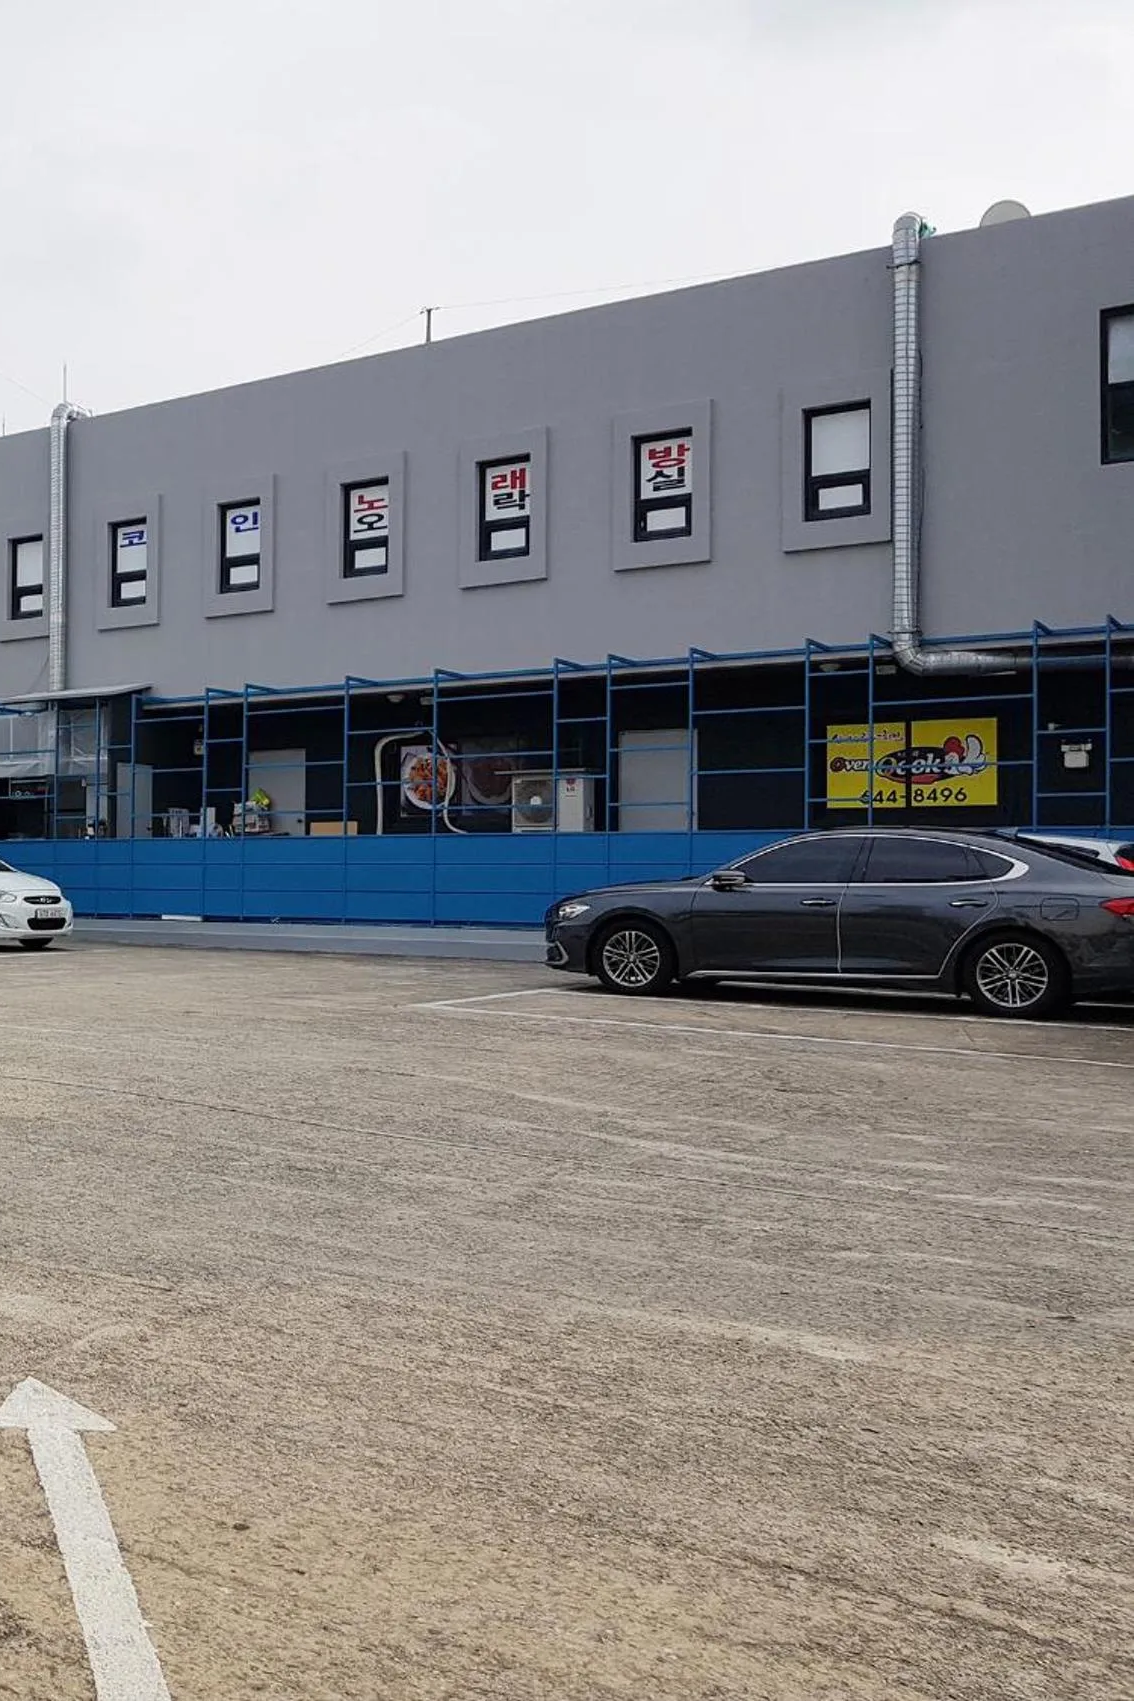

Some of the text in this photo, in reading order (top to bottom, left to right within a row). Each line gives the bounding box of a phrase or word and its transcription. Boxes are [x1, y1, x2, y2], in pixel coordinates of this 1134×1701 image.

[119, 443, 690, 548] 코 인 노 래 방
[353, 466, 686, 533] 오 락 실
